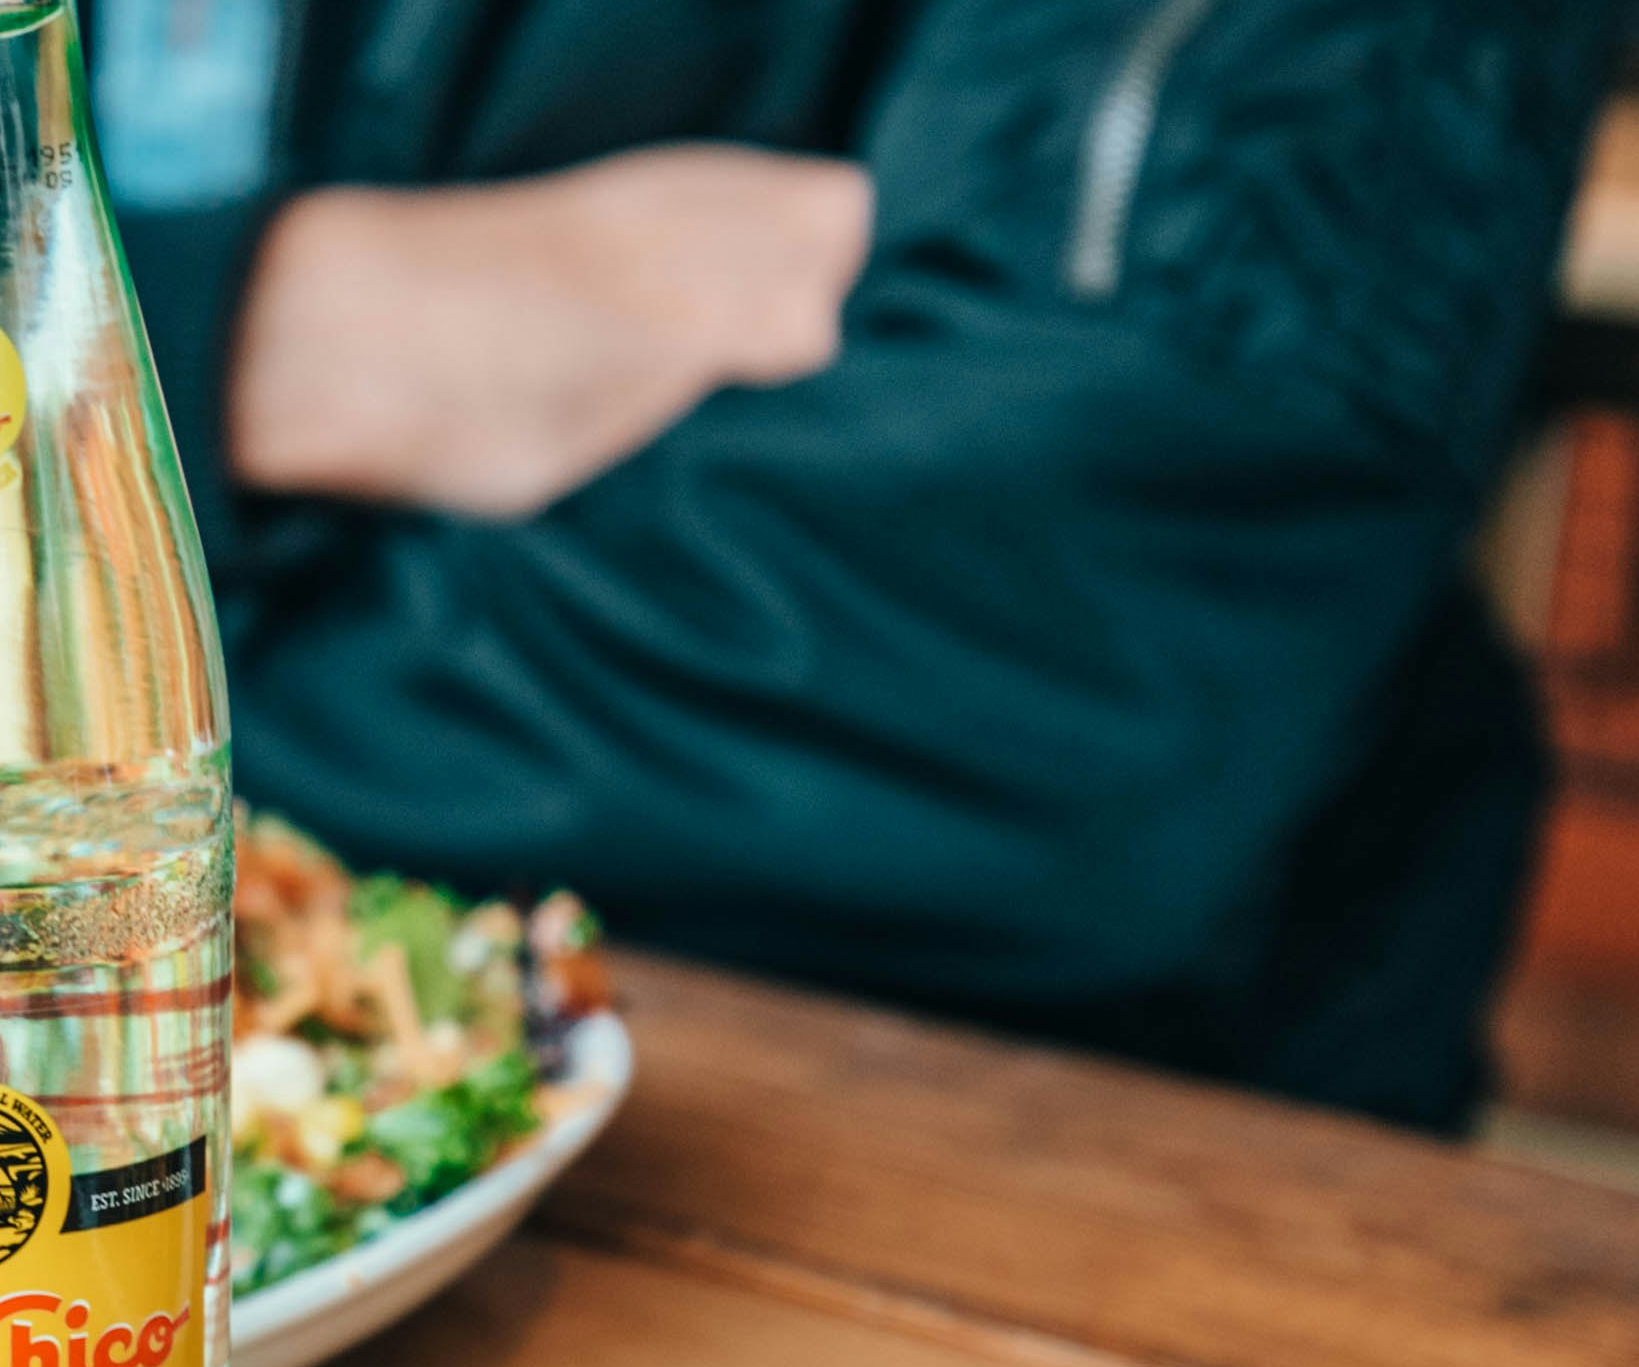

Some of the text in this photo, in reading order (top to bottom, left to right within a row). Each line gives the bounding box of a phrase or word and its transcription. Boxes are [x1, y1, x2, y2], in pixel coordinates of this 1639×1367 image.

[11, 1098, 53, 1145] WATER
[90, 1191, 121, 1213] EST.
[122, 1179, 161, 1206] SINCE
